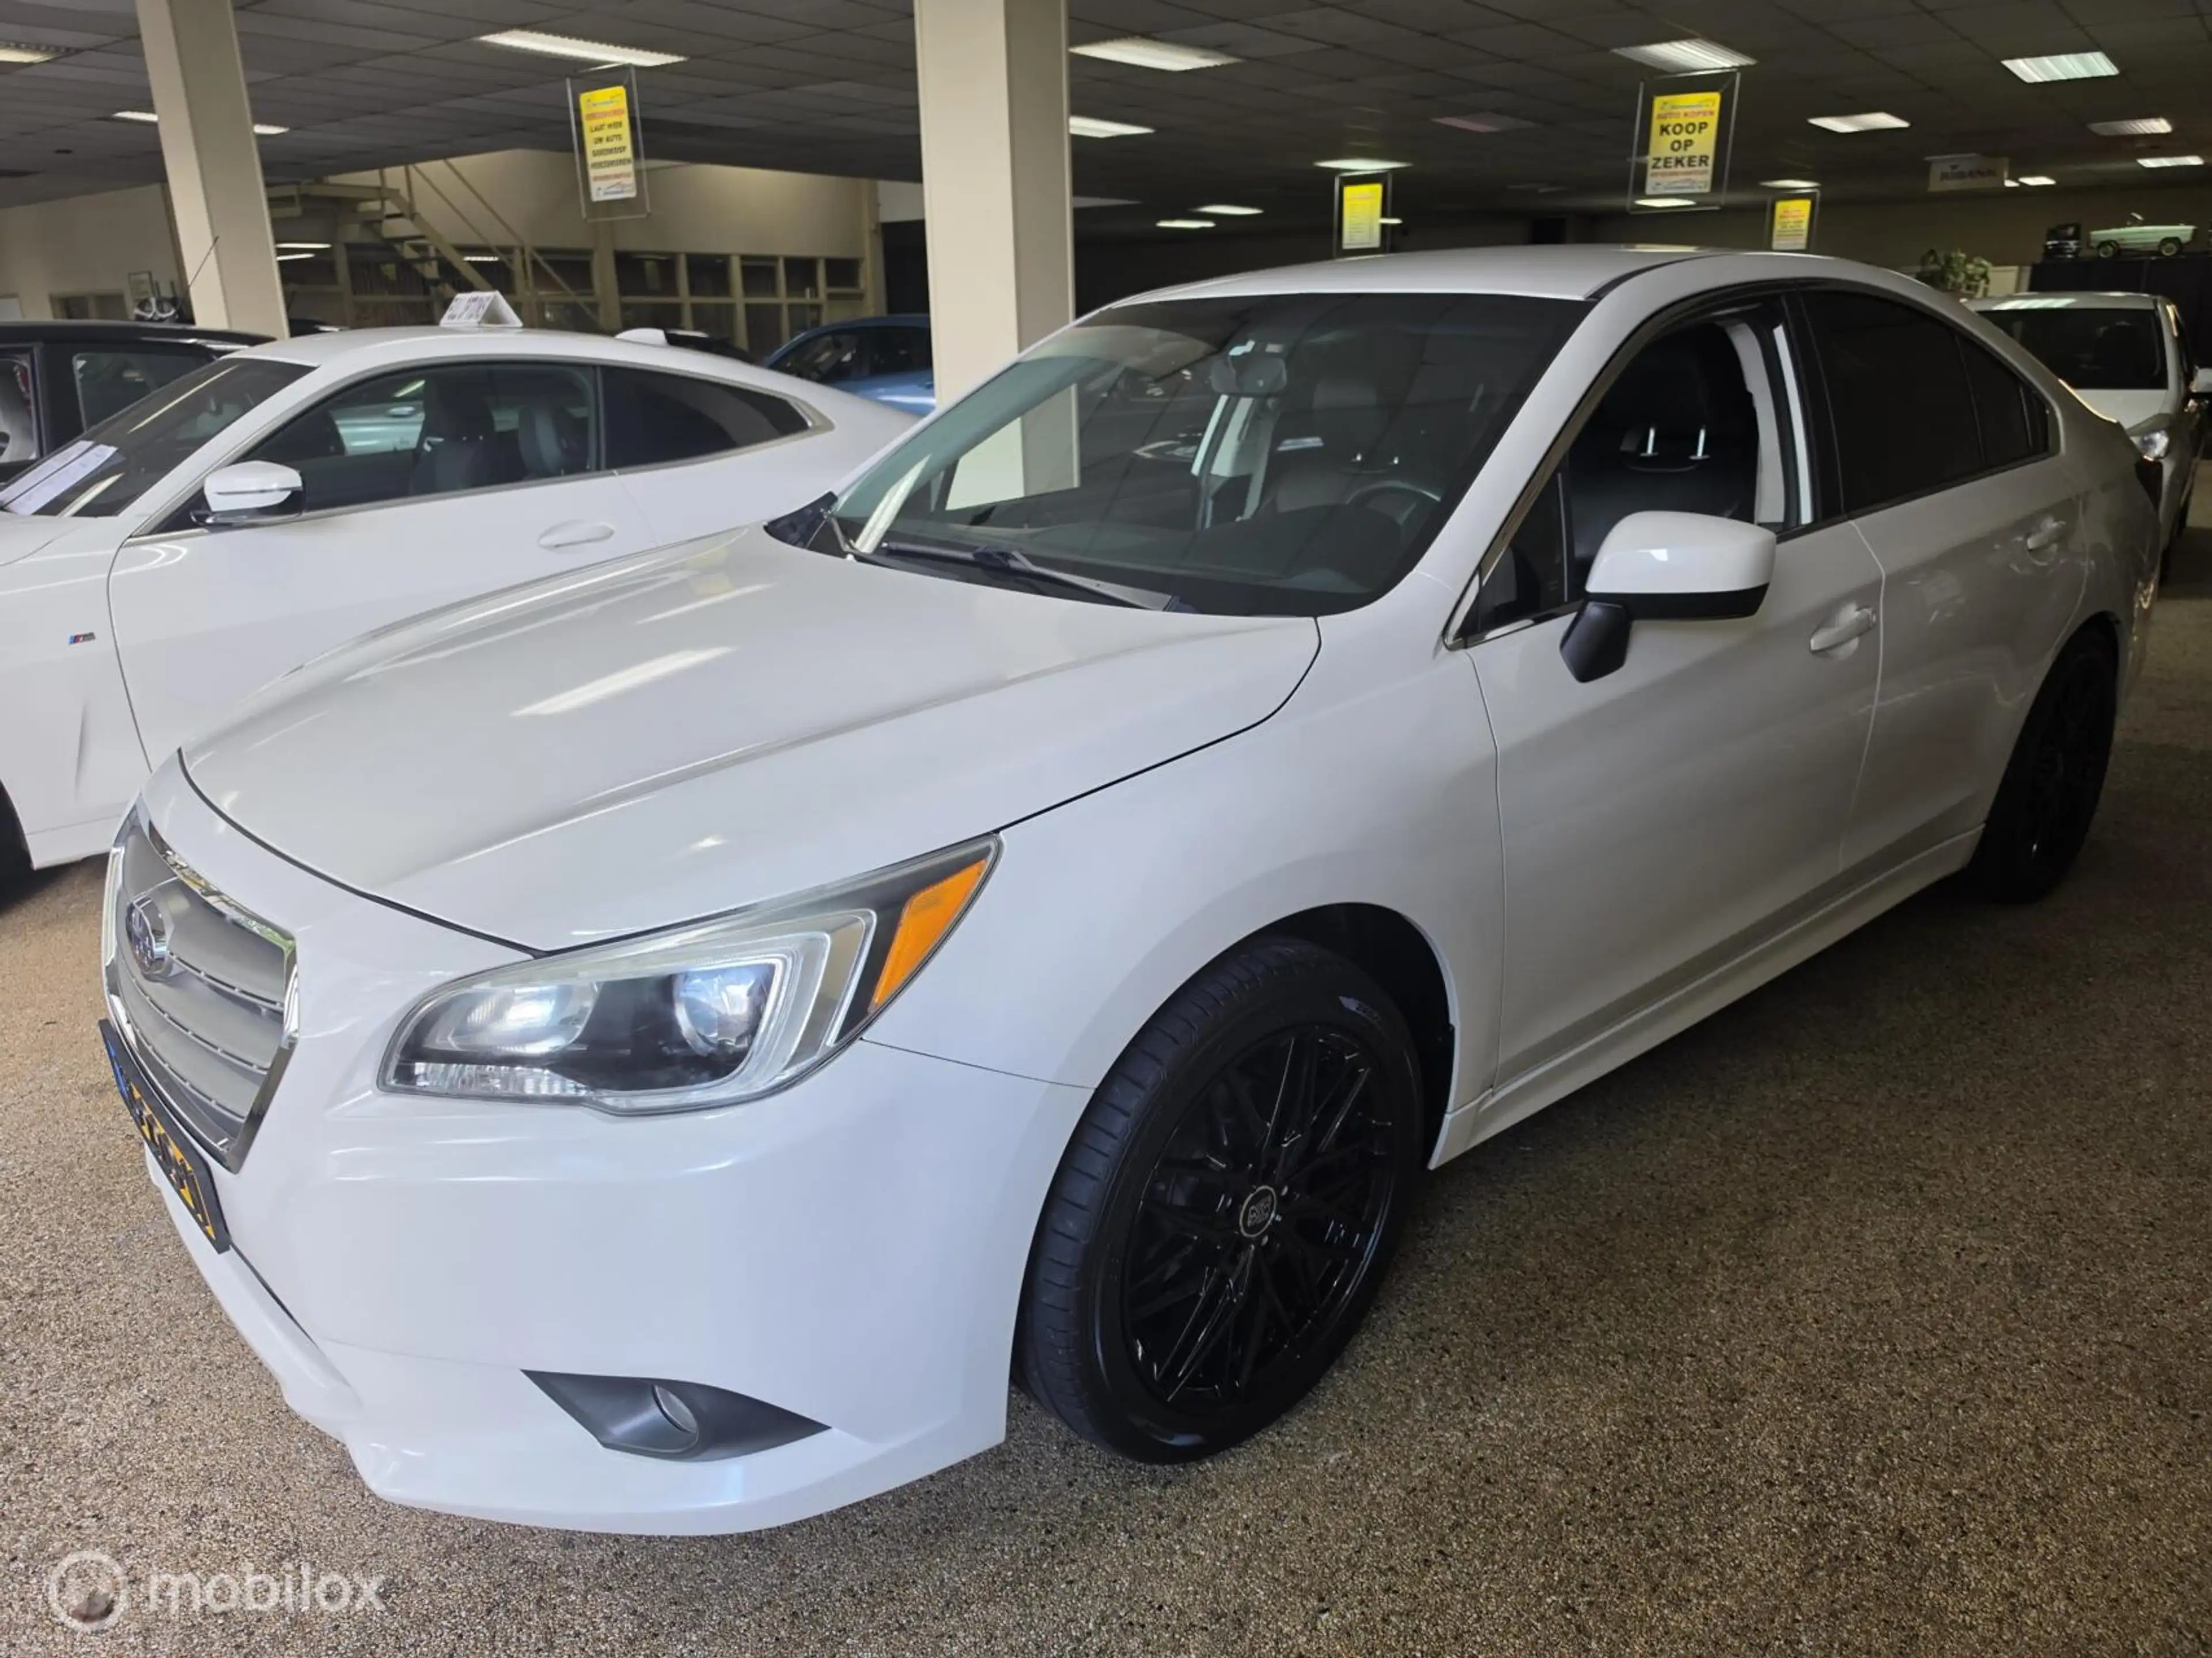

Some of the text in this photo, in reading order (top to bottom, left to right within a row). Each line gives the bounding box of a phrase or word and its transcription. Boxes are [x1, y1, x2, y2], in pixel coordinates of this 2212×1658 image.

[1659, 122, 1709, 136] KOOP
[1671, 139, 1694, 152] OP
[1652, 155, 1709, 170] ZEKER
